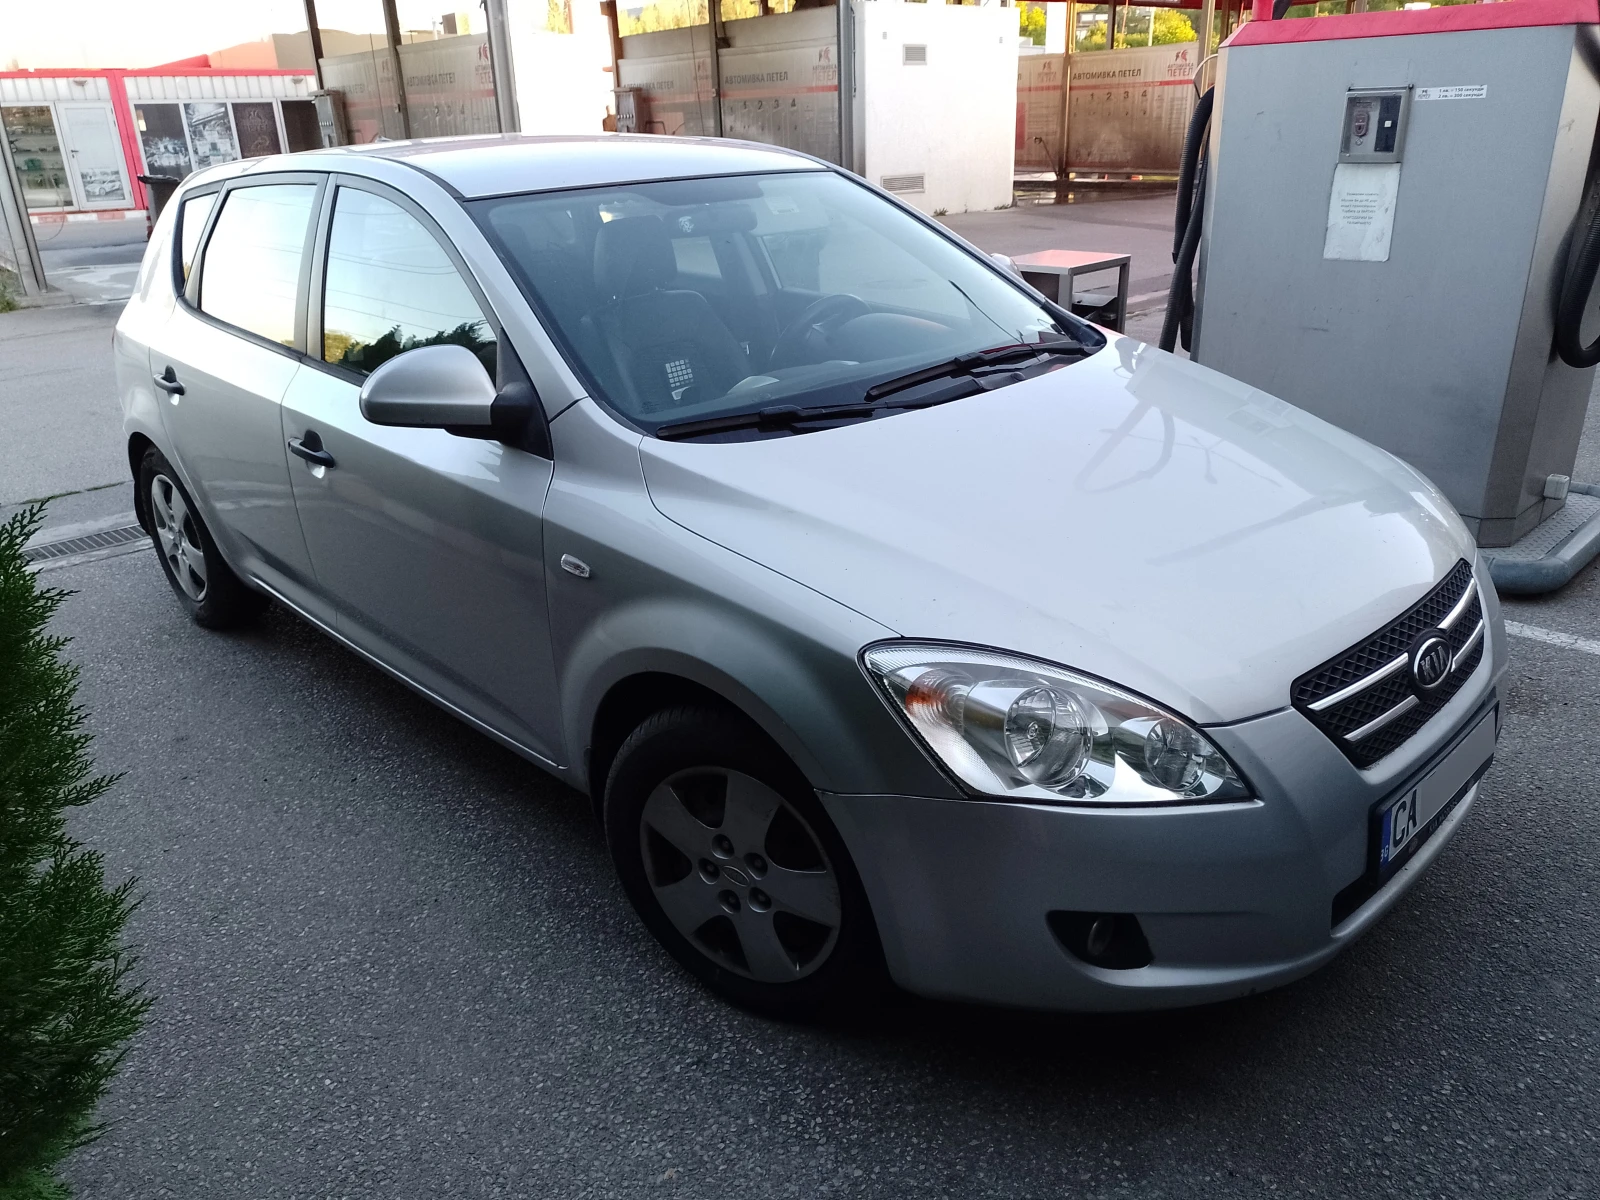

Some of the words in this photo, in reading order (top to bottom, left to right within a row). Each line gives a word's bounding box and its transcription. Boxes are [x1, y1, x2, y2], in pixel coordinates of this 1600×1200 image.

[724, 72, 766, 85] АВТОМИВКА
[766, 71, 789, 82] ПЕТЕЛ
[1072, 70, 1117, 81] АВТОМИВКА
[1117, 68, 1142, 79] ПЕТЕЛ
[1167, 67, 1193, 77] ПЕТЕЛ
[1106, 91, 1112, 101] 2
[1124, 90, 1130, 100] 3
[1142, 89, 1148, 98] 4
[758, 100, 763, 111] 2
[774, 99, 780, 109] 3
[790, 98, 797, 108] 4
